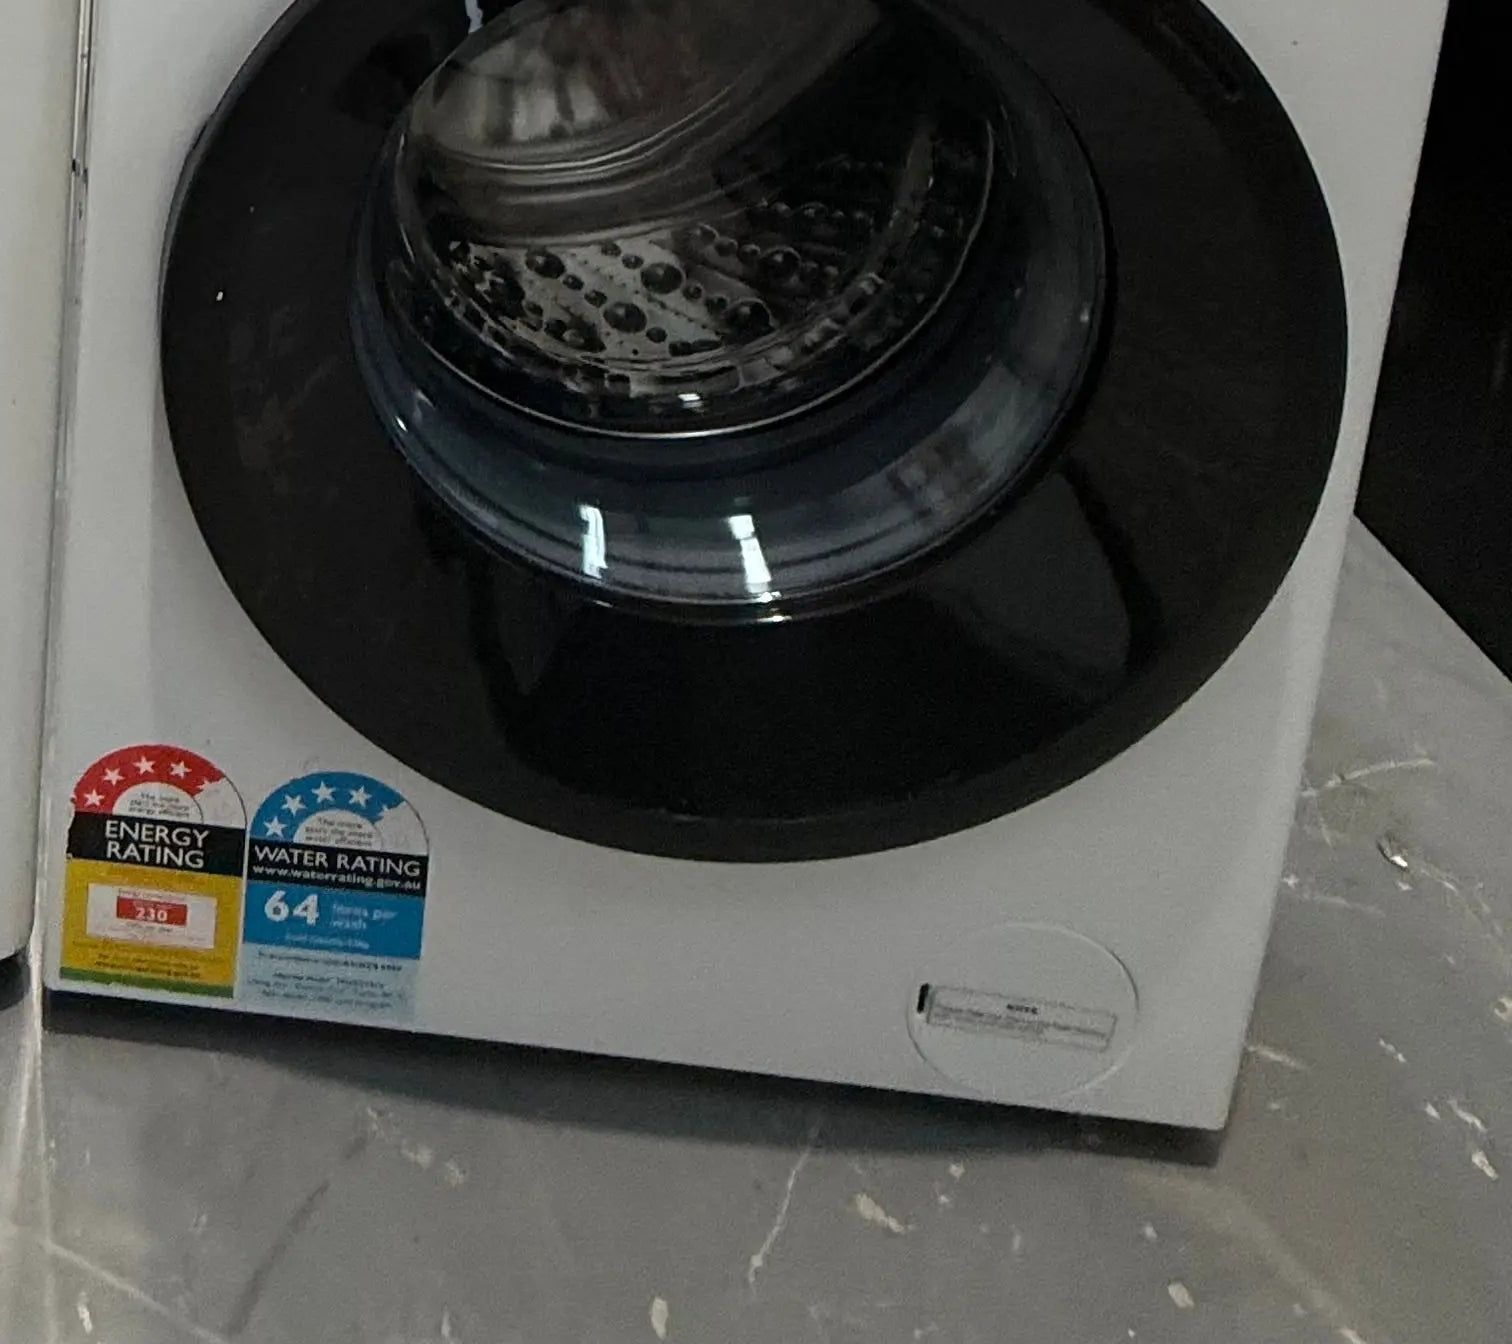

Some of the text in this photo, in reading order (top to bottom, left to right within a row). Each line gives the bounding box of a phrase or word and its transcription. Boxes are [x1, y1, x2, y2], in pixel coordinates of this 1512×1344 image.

[105, 819, 209, 848] ENERGY
[106, 840, 205, 869] RATING
[254, 844, 421, 878] WATER RATING
[253, 864, 421, 891] www.waterrating.gov.au
[264, 889, 319, 927] 64
